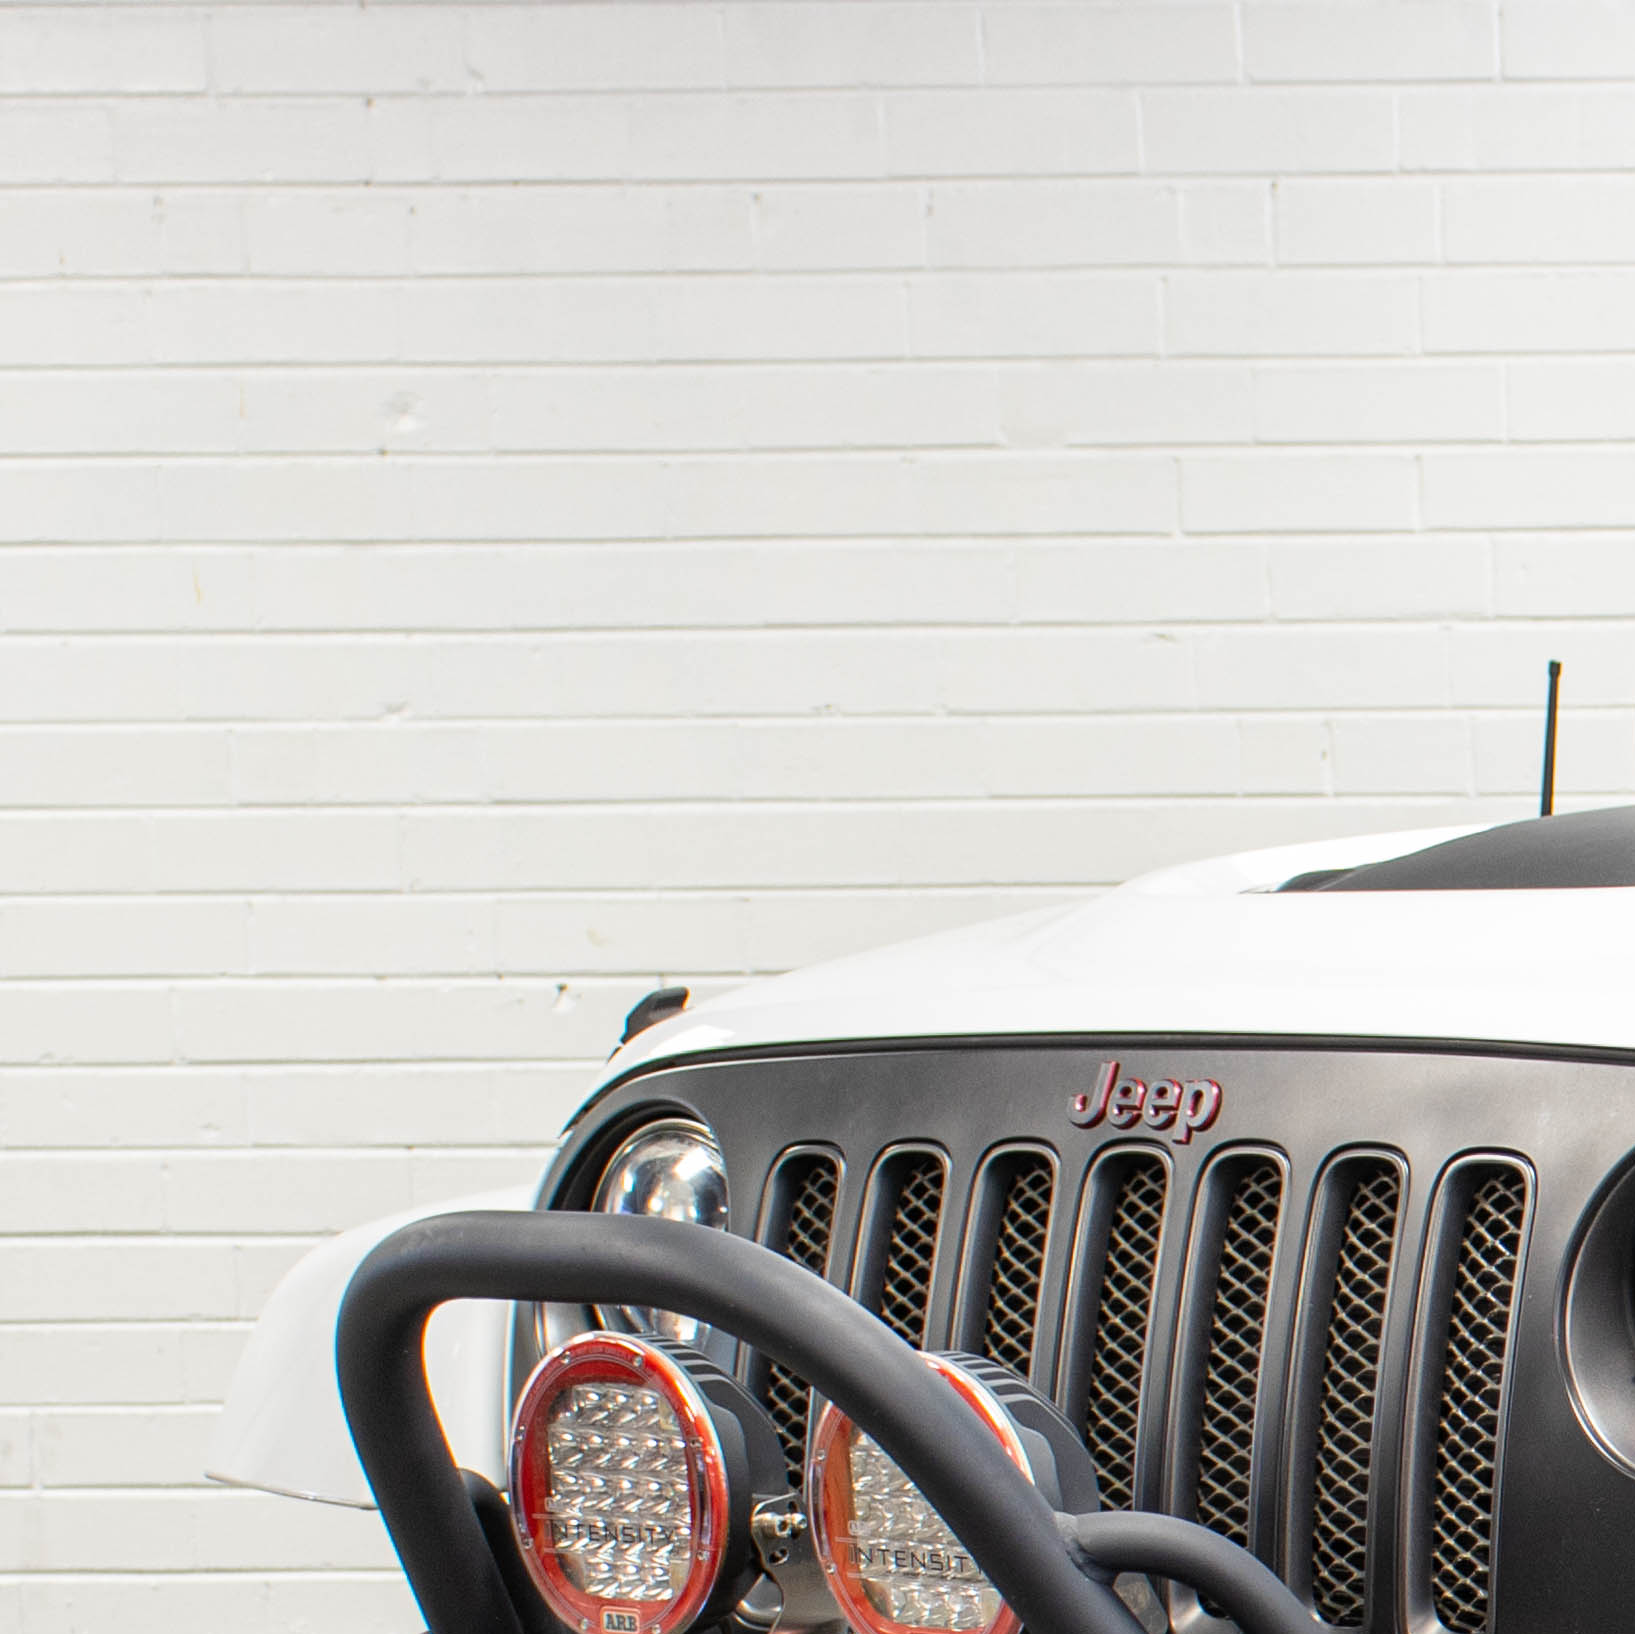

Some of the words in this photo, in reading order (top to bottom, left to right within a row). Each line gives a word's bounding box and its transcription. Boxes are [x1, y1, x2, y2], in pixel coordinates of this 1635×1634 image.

[1066, 1060, 1223, 1145] Jeep
[545, 1515, 676, 1546] INTENSITY
[604, 1612, 638, 1632] ARB
